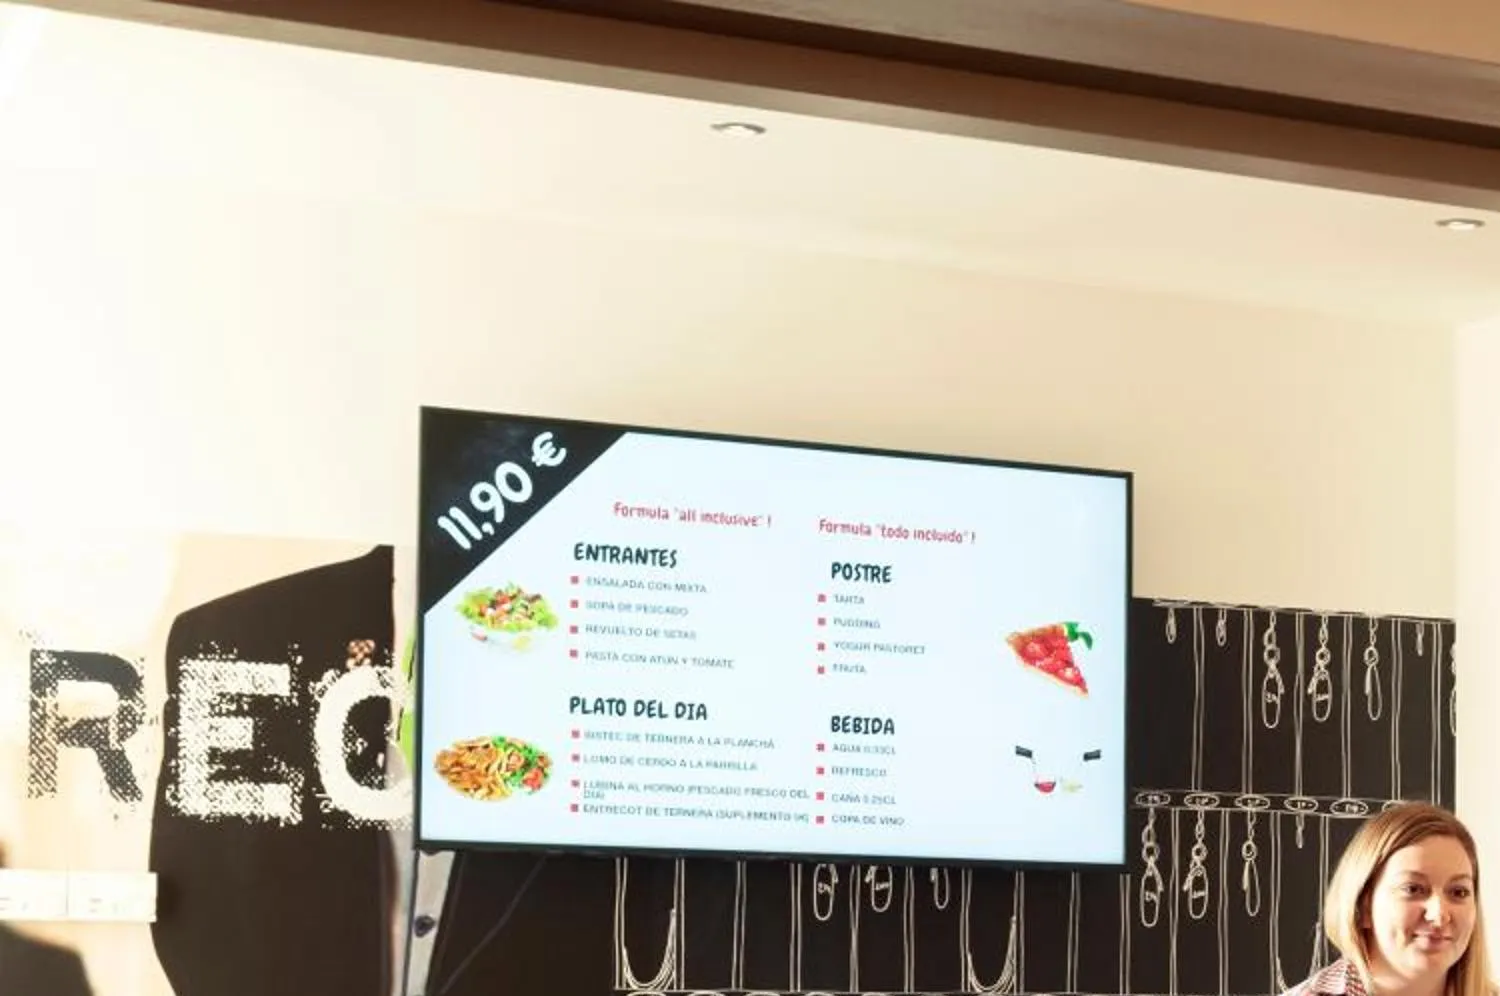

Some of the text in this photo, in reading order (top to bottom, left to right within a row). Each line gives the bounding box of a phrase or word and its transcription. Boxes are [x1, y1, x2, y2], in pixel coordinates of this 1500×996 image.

[437, 431, 567, 550] 11,90 €
[613, 501, 669, 521] Formula
[818, 519, 871, 537] Formula
[574, 542, 678, 569] ENTRANTES
[831, 561, 893, 584] POSTRE
[585, 576, 708, 594] ENSALADA CON MIXTA
[617, 602, 632, 613] DE
[635, 604, 689, 617] PESCADO
[585, 624, 643, 638] REVUELTO
[645, 628, 659, 639] DE
[585, 650, 619, 662] PASTA
[622, 652, 647, 664] CON
[692, 657, 735, 670] TOMATE
[569, 696, 709, 721] PLATO DEL DIA
[831, 715, 896, 735] BEBIDA
[626, 733, 641, 743] DE
[644, 734, 694, 746] TERNERA
[707, 737, 722, 747] LA
[832, 743, 861, 754] AGUA
[584, 755, 617, 766] LOMO
[620, 757, 635, 767] DE
[638, 757, 677, 769] CERDO
[689, 759, 705, 769] LA
[627, 783, 642, 793] AL
[643, 783, 685, 795] HORNO
[744, 786, 788, 799] FRESCO
[790, 788, 810, 800] DEL
[583, 804, 642, 818] ENTRECOT
[646, 806, 661, 817] DE
[665, 807, 713, 819] TERNERA
[862, 815, 877, 826] DE
[879, 816, 905, 827] VINO
